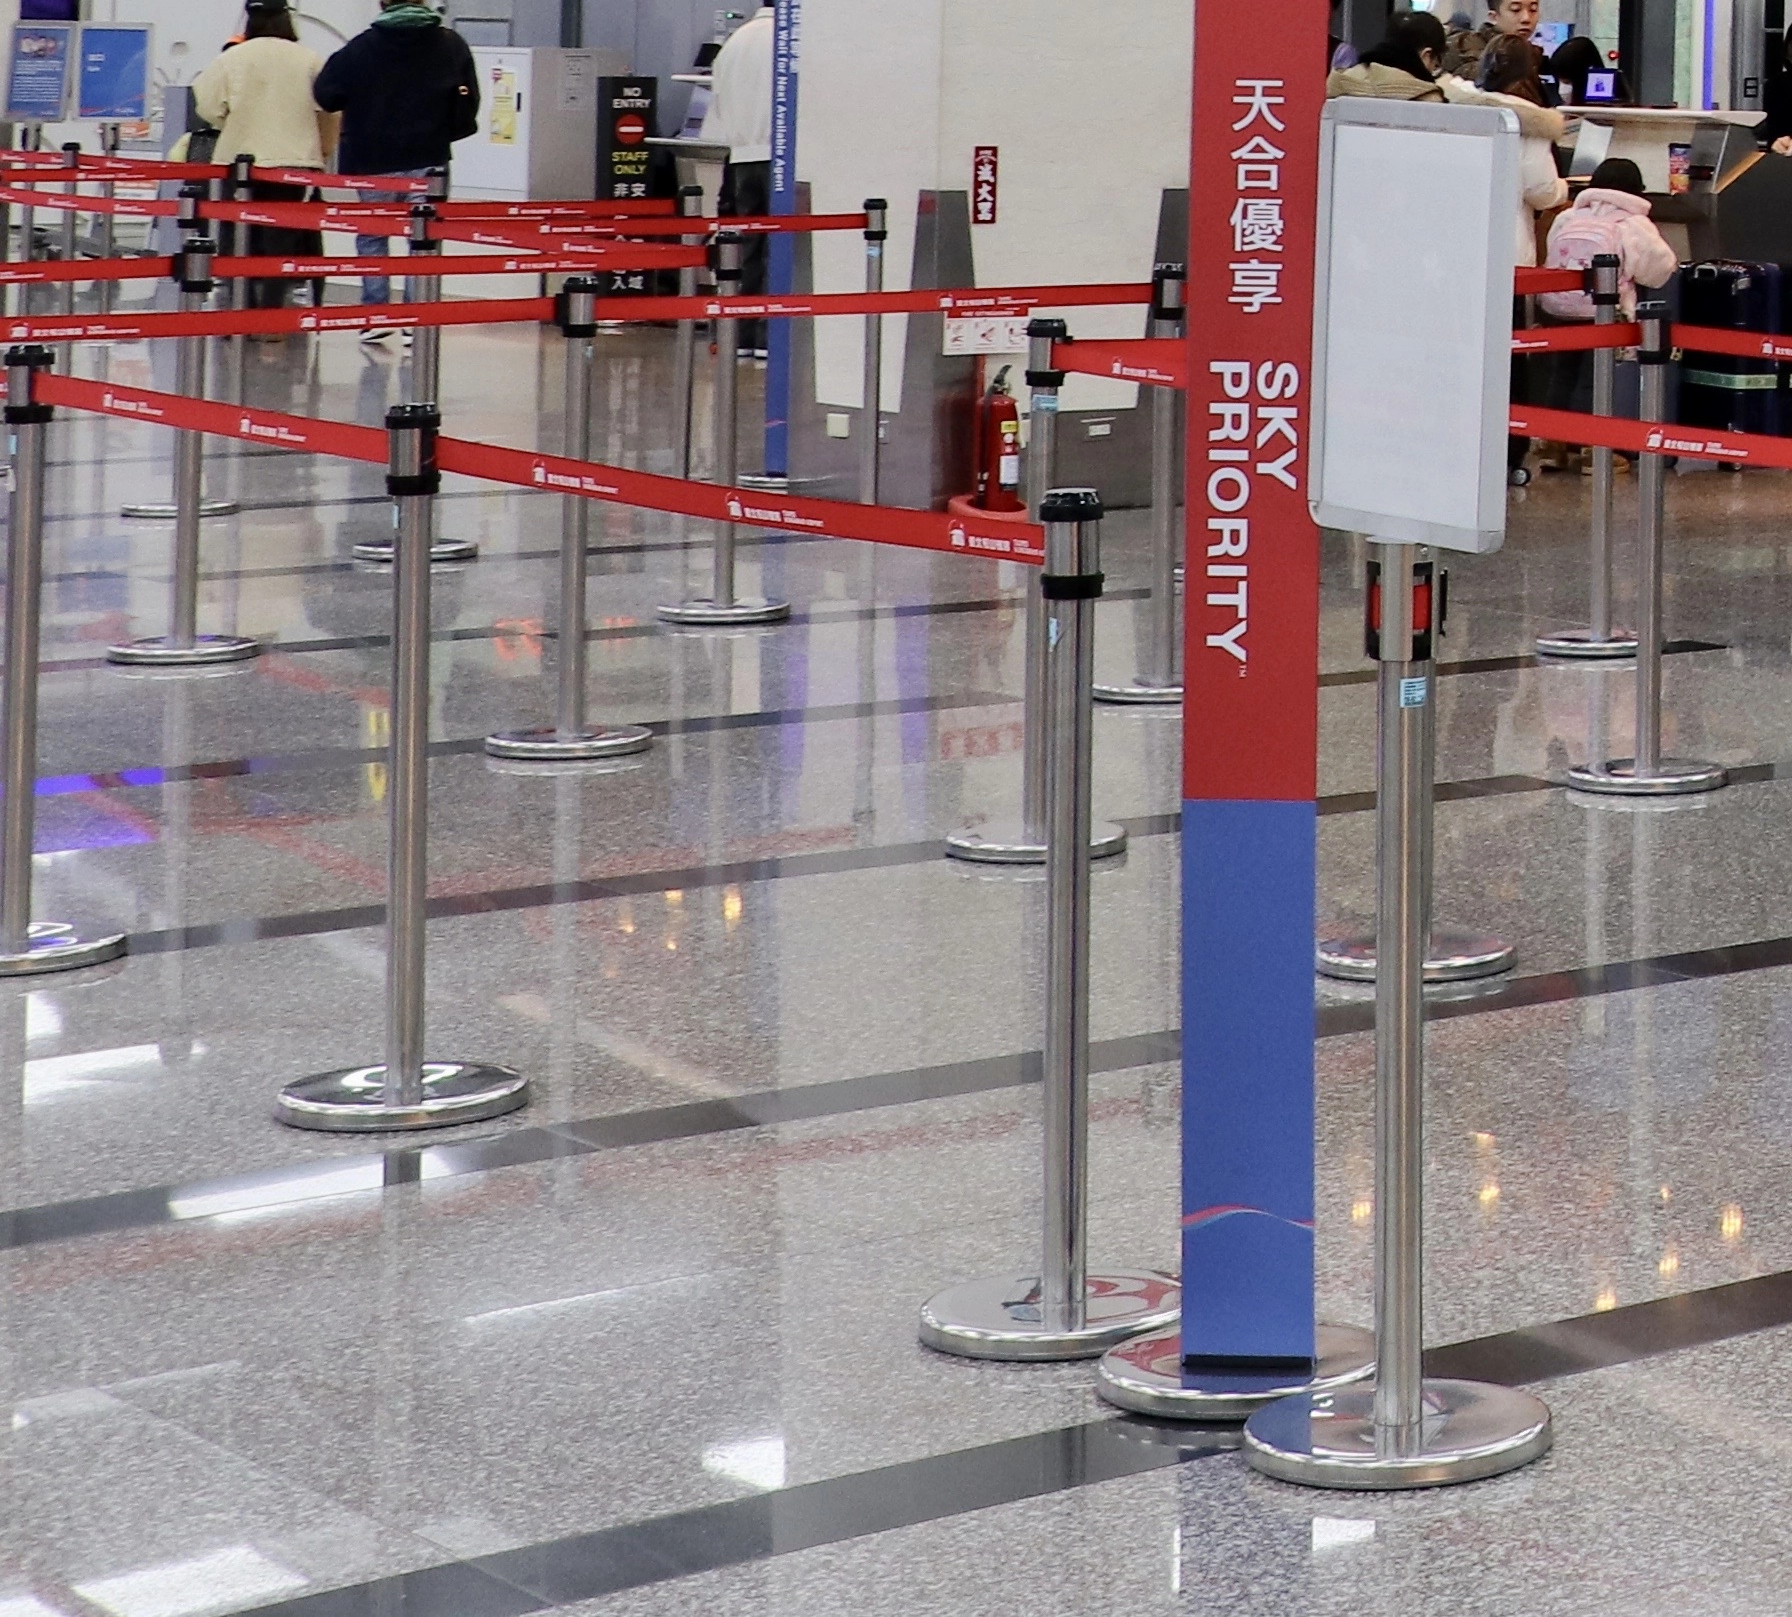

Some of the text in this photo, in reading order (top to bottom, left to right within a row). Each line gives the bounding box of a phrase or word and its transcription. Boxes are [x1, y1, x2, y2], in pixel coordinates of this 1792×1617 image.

[612, 98, 652, 109] ENTRY
[623, 87, 642, 97] NO
[776, 76, 788, 102] Next
[775, 104, 788, 156] Available
[611, 151, 650, 162] STAFF
[614, 164, 647, 175] ONLY
[773, 158, 786, 192] Agent
[1227, 77, 1286, 314] 天合優享
[1256, 360, 1299, 491] SKY
[1205, 360, 1252, 664] PRIORITY
